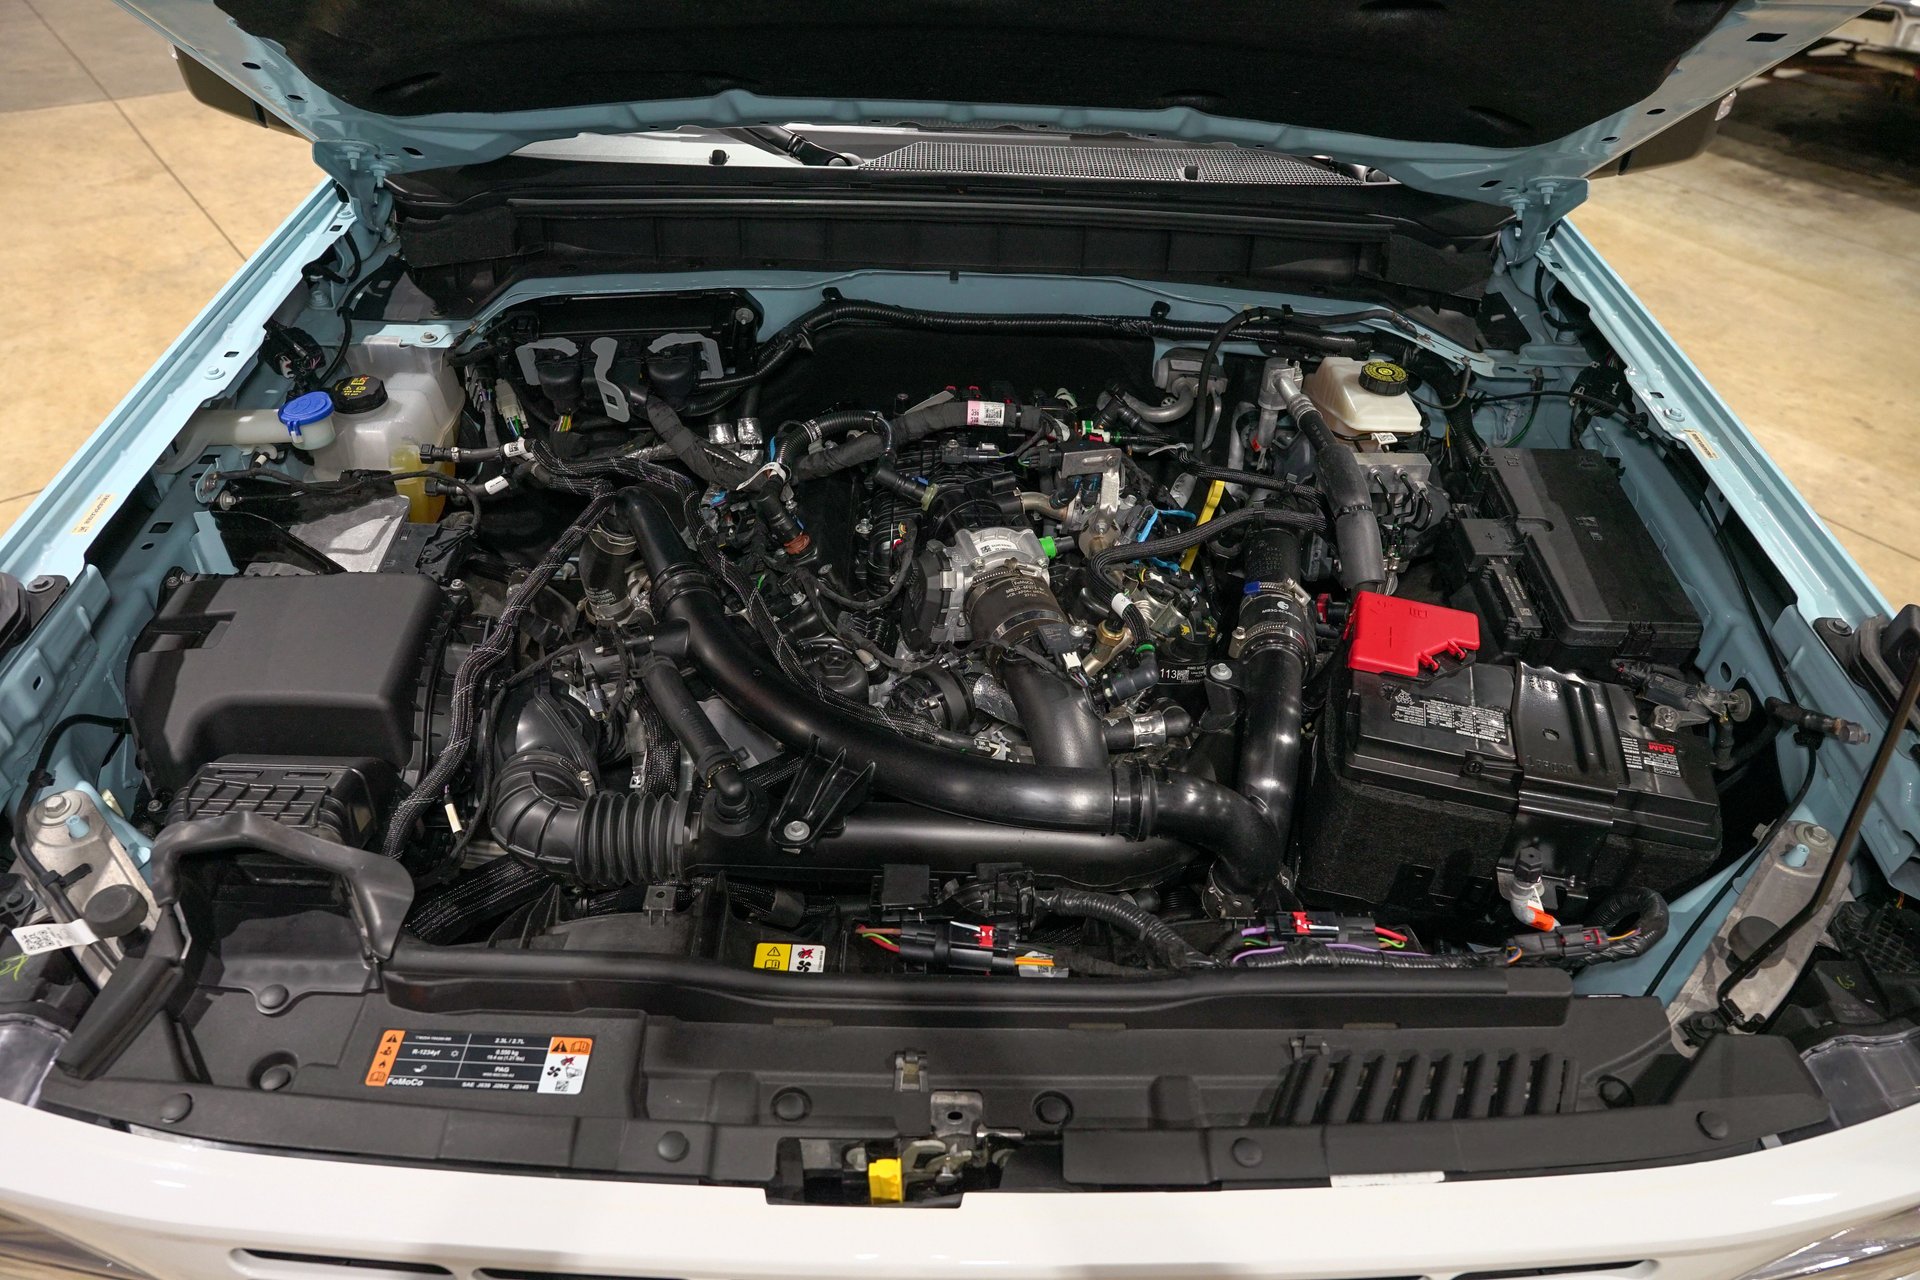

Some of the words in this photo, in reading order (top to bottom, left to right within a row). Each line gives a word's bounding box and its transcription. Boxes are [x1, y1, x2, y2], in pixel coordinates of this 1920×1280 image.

[1160, 668, 1177, 679] 113
[1648, 744, 1675, 754] AGM
[411, 1048, 441, 1057] R-1234yf
[386, 1077, 424, 1087] FoMoCo
